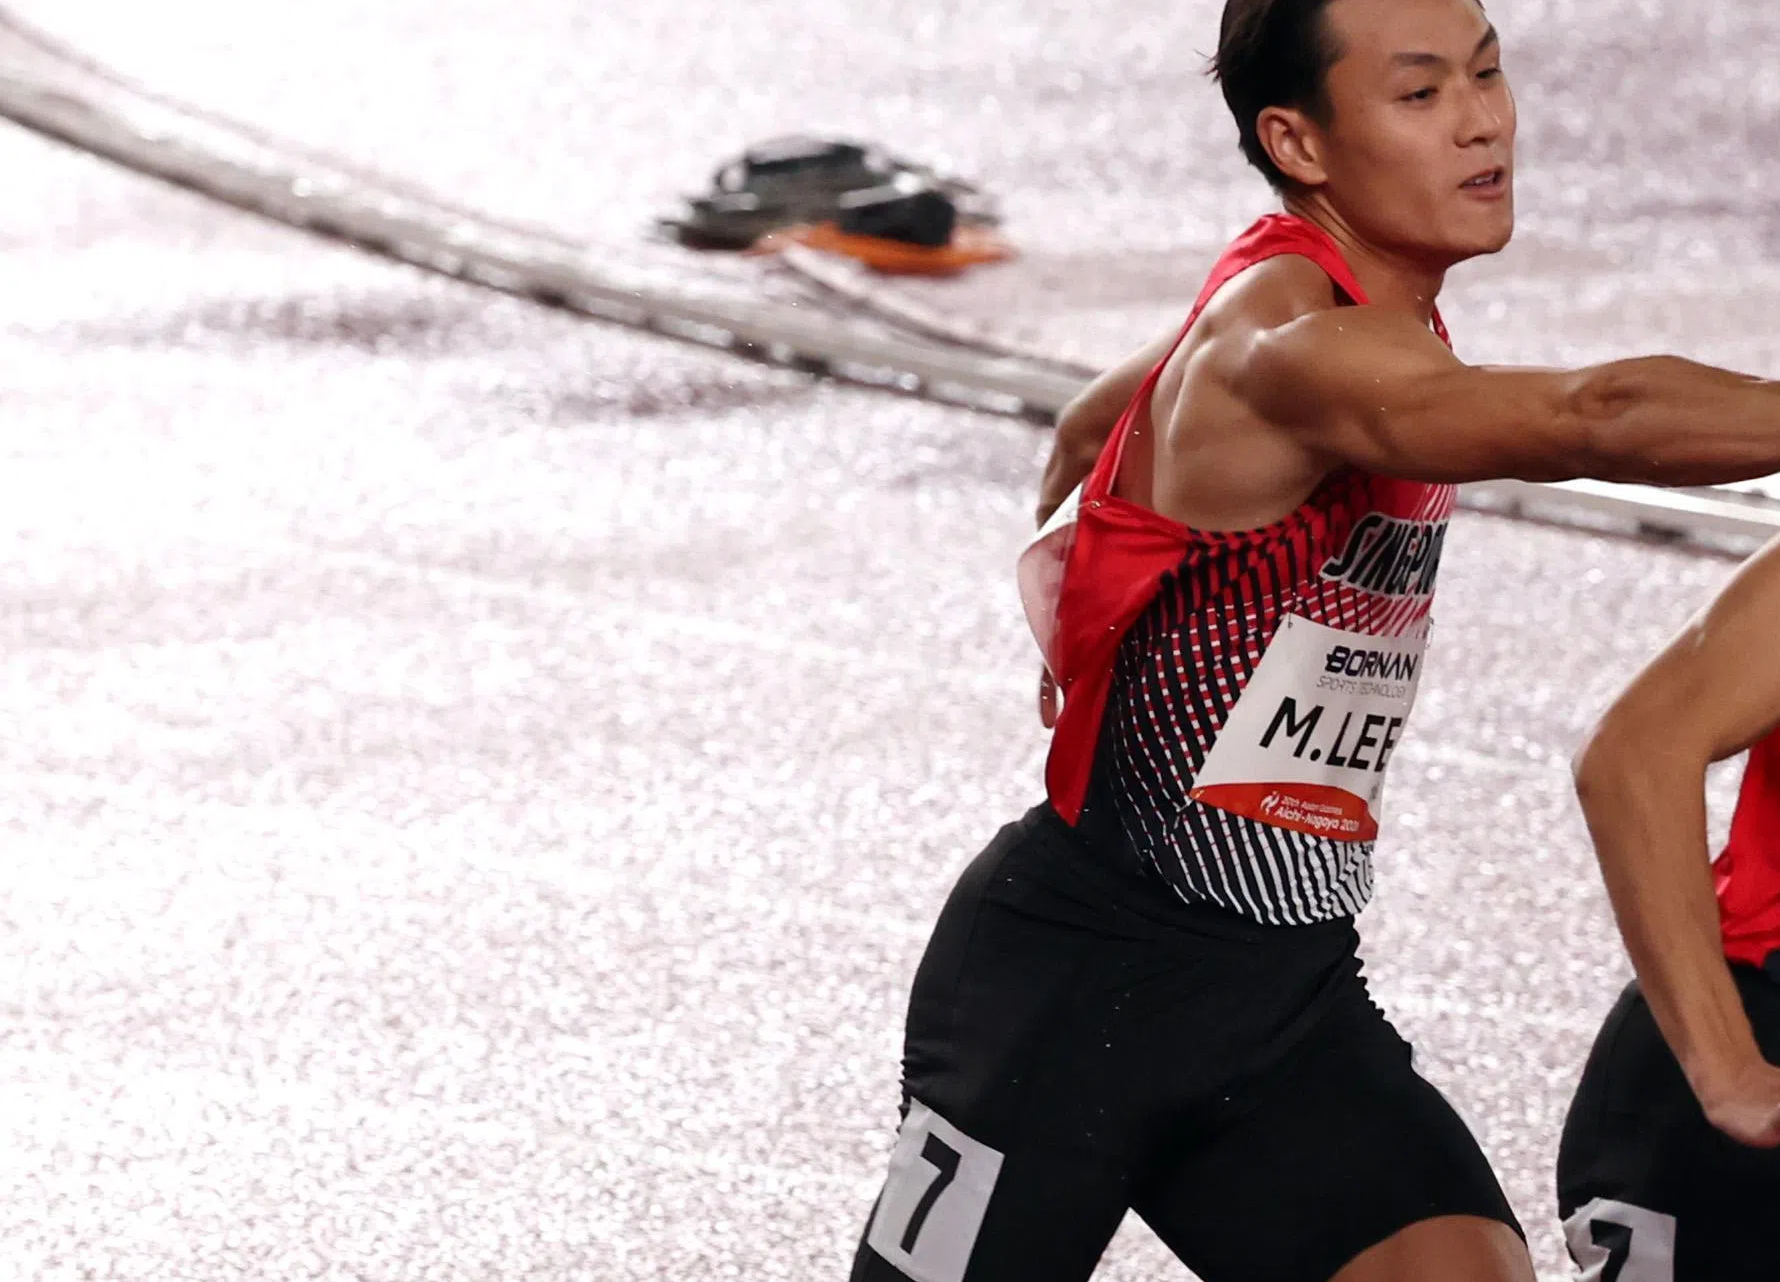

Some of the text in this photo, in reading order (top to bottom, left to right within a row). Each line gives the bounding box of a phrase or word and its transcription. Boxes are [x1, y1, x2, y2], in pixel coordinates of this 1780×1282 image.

[1325, 645, 1418, 681] BORNAN
[1259, 696, 1402, 772] M.LEE
[900, 1131, 962, 1256] 7
